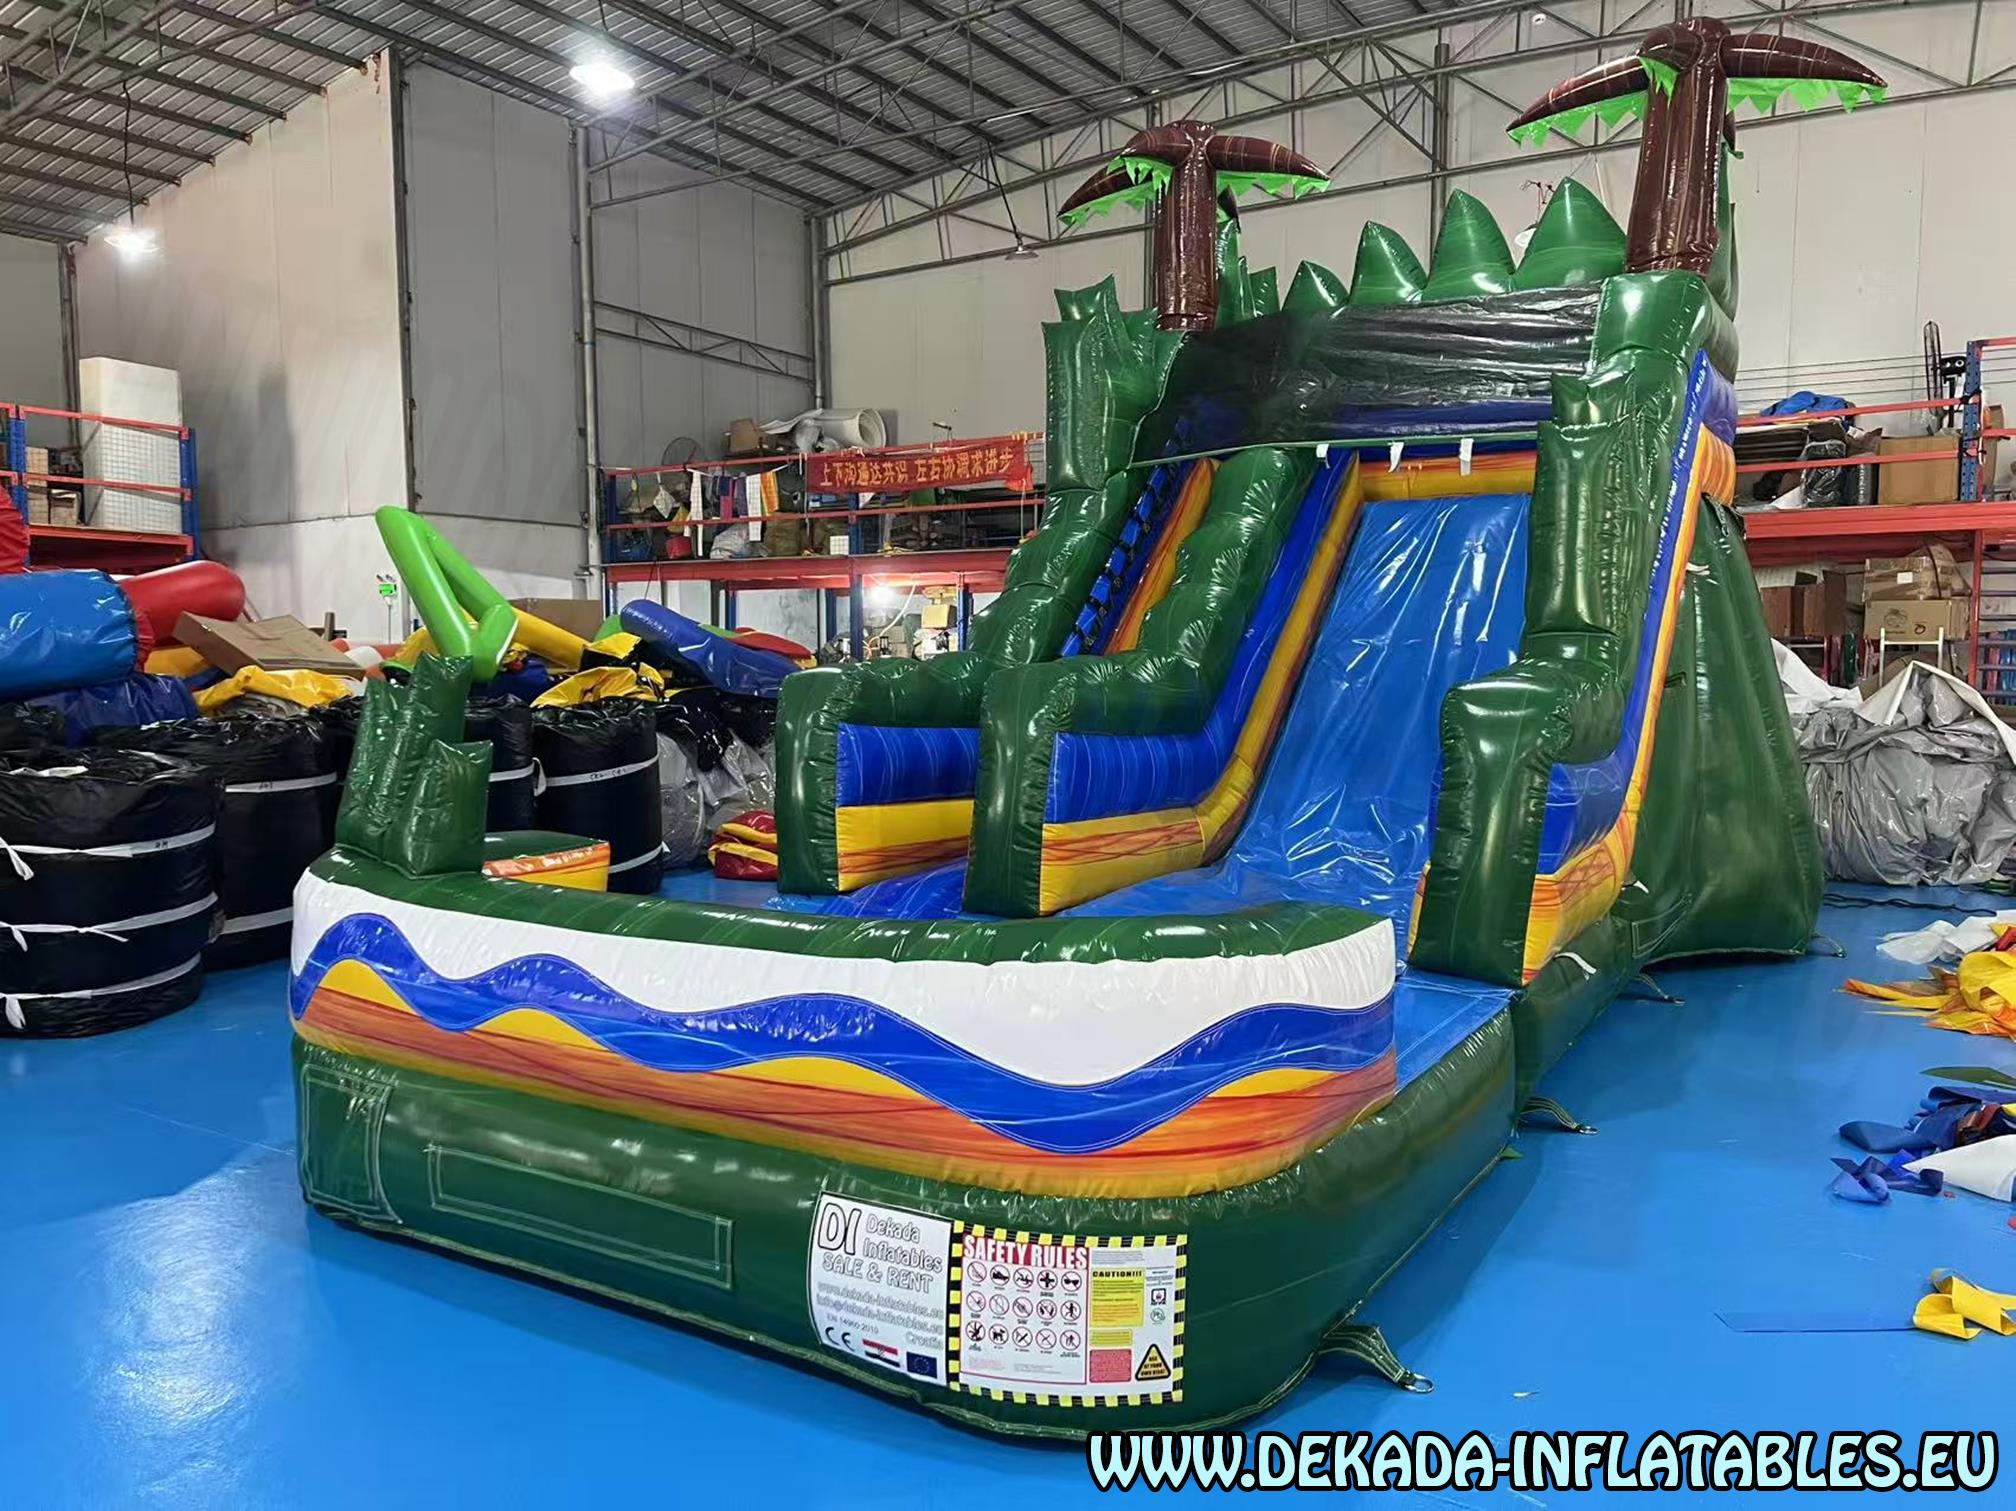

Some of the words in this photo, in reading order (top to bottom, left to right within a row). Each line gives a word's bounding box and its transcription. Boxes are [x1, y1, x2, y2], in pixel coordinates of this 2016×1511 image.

[818, 1202, 862, 1256] DI
[866, 1213, 920, 1243] Dekada
[863, 1238, 943, 1273] Inflatables
[964, 1235, 1028, 1266] SAFETY
[1031, 1244, 1087, 1269] RULES
[822, 1252, 864, 1279] SALE
[866, 1262, 883, 1283] &
[887, 1266, 933, 1293] RENT
[1092, 1270, 1142, 1278] CAUTION!!!
